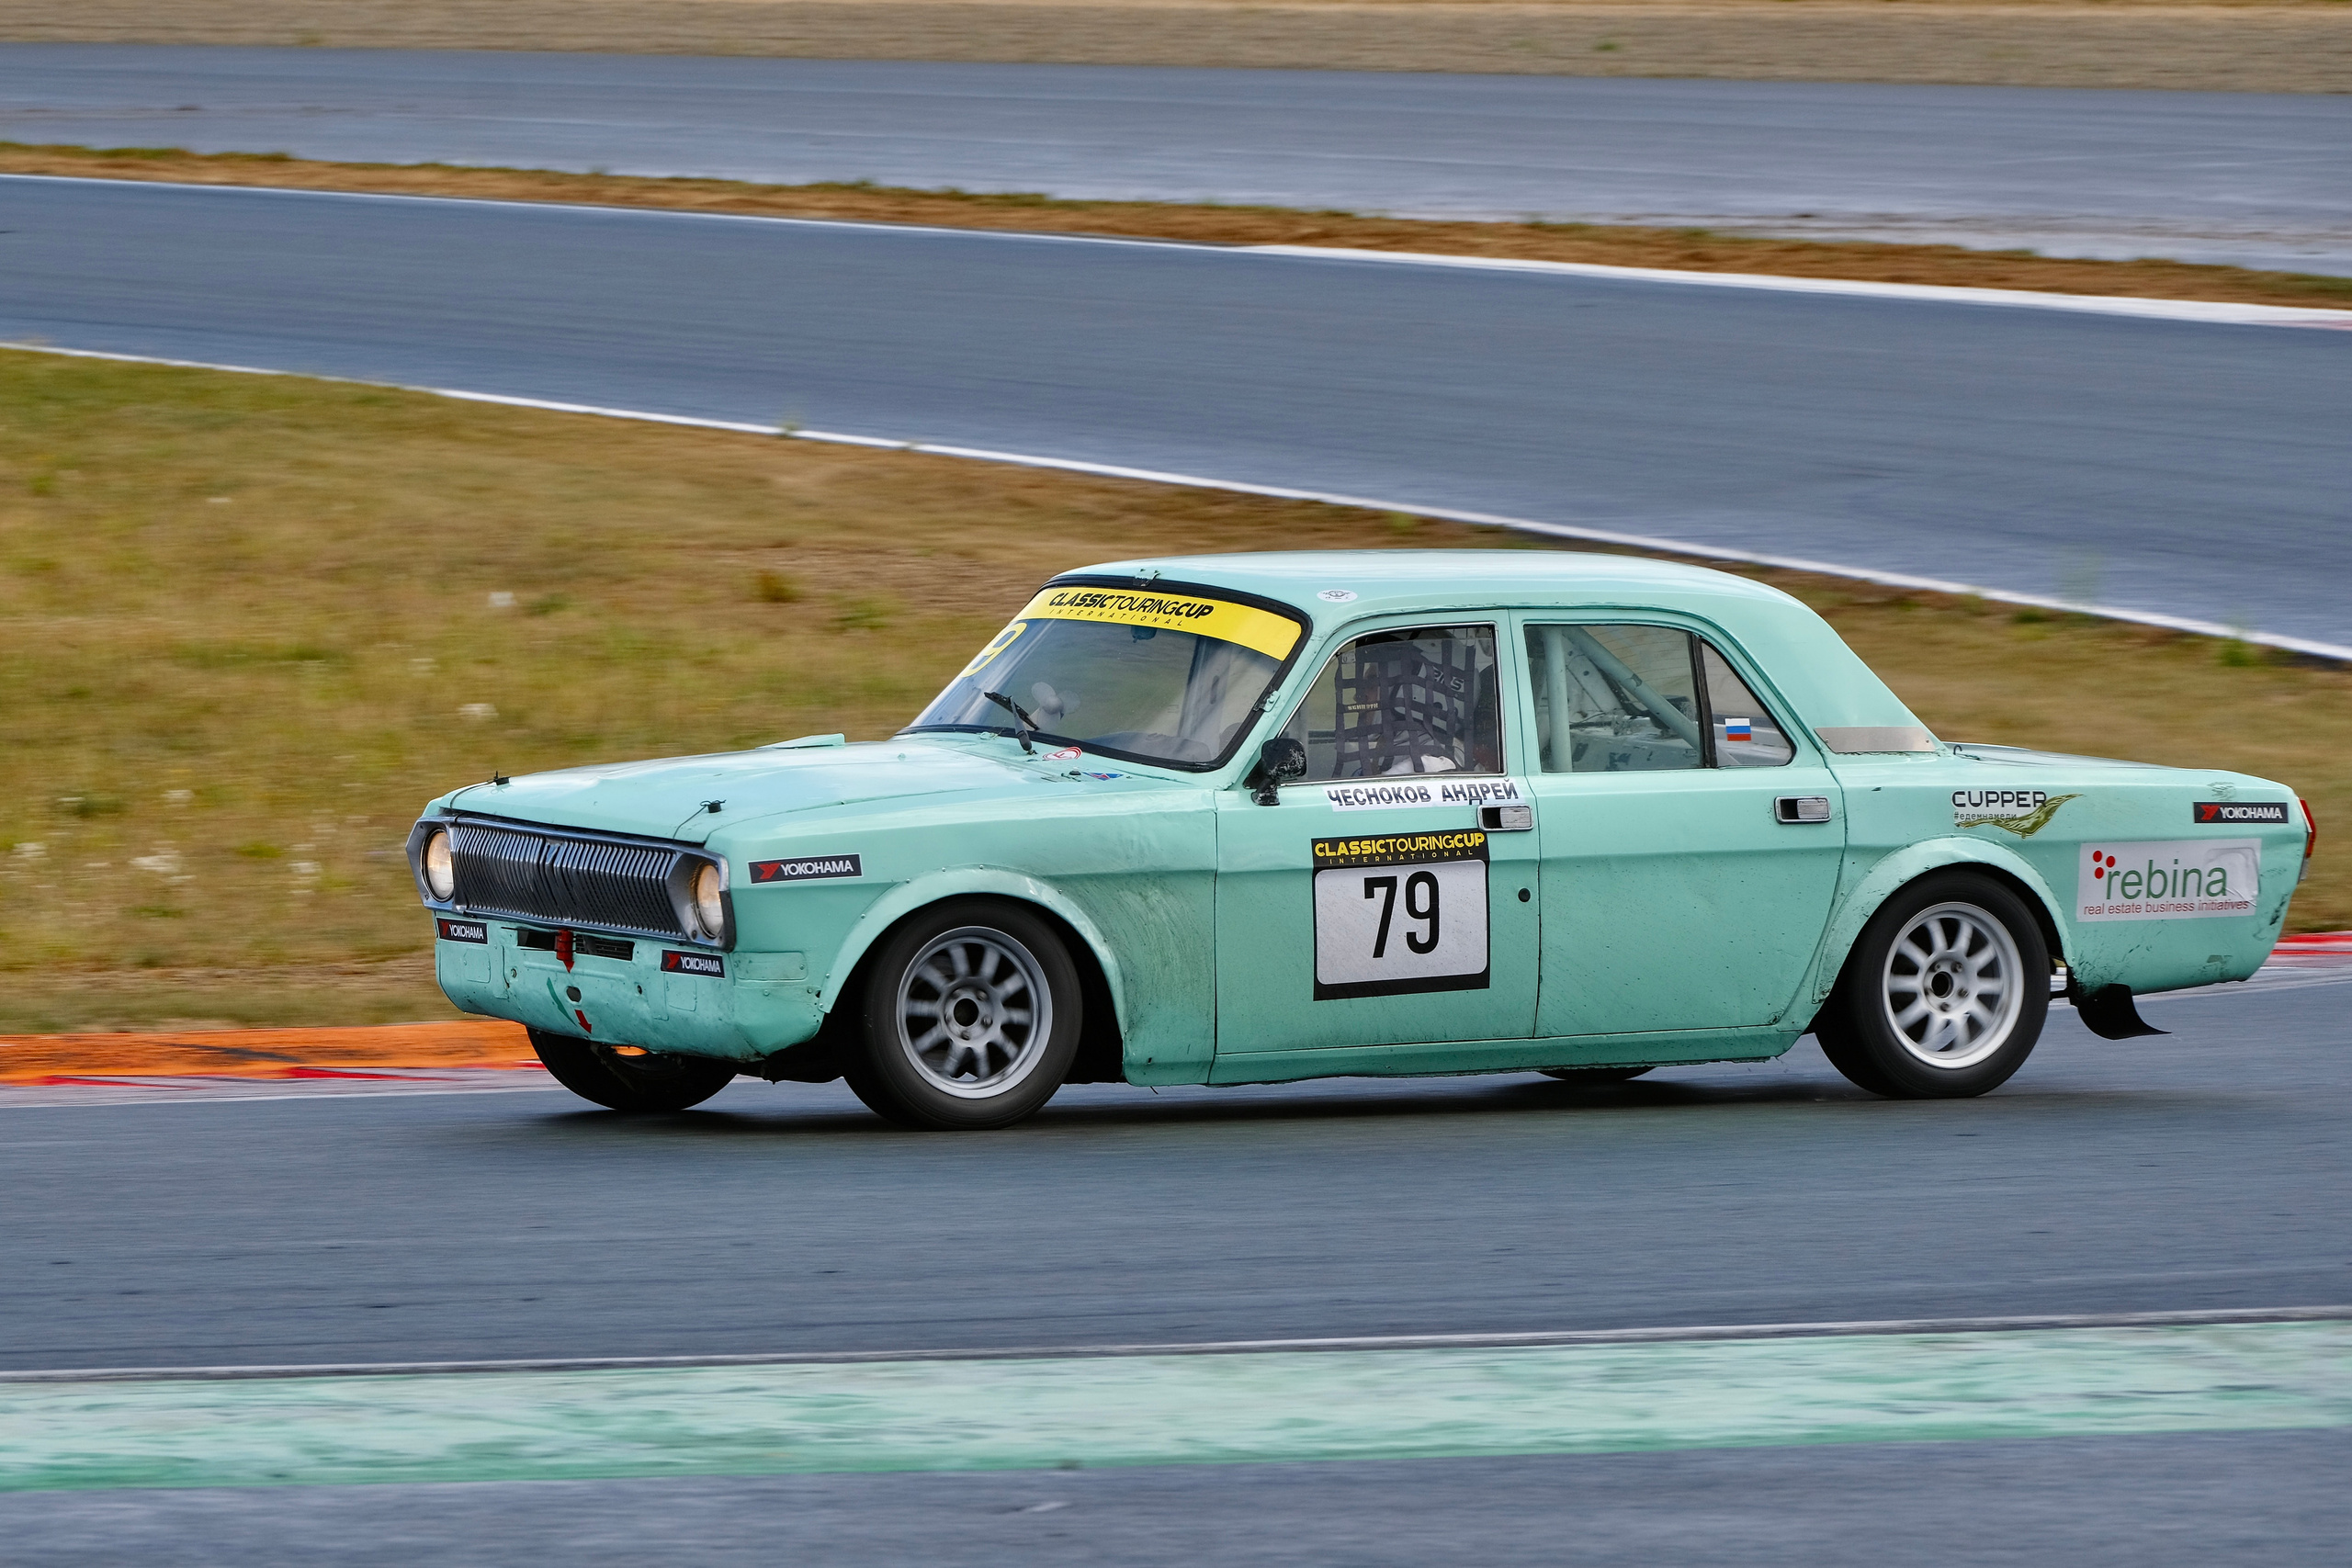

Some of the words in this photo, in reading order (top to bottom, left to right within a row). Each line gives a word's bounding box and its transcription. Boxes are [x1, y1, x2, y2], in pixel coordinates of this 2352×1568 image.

[1049, 592, 1215, 619] CLASSICTOURINGCUP
[1049, 609, 1182, 626] INTERNATIONAL
[1327, 785, 1431, 806] ЧЕСНОКОВ
[1442, 778, 1520, 806] АНДРЕЙ
[1951, 791, 2048, 807] CUPPER
[2220, 807, 2283, 819] YOKOHAMA
[1315, 832, 1486, 857] CLASSICTOURINGCUP
[1329, 851, 1474, 864] INTERNATIONAL
[780, 860, 854, 876] YOKOHAMA
[2106, 859, 2228, 900] rebina
[1363, 871, 1441, 958] 79
[2084, 903, 2105, 915] real
[2108, 901, 2143, 914] estate
[2145, 900, 2195, 913] business
[2198, 898, 2249, 911] initiatives
[448, 923, 484, 940] YOKOHAMA
[680, 956, 721, 973] YOKOHAMA
